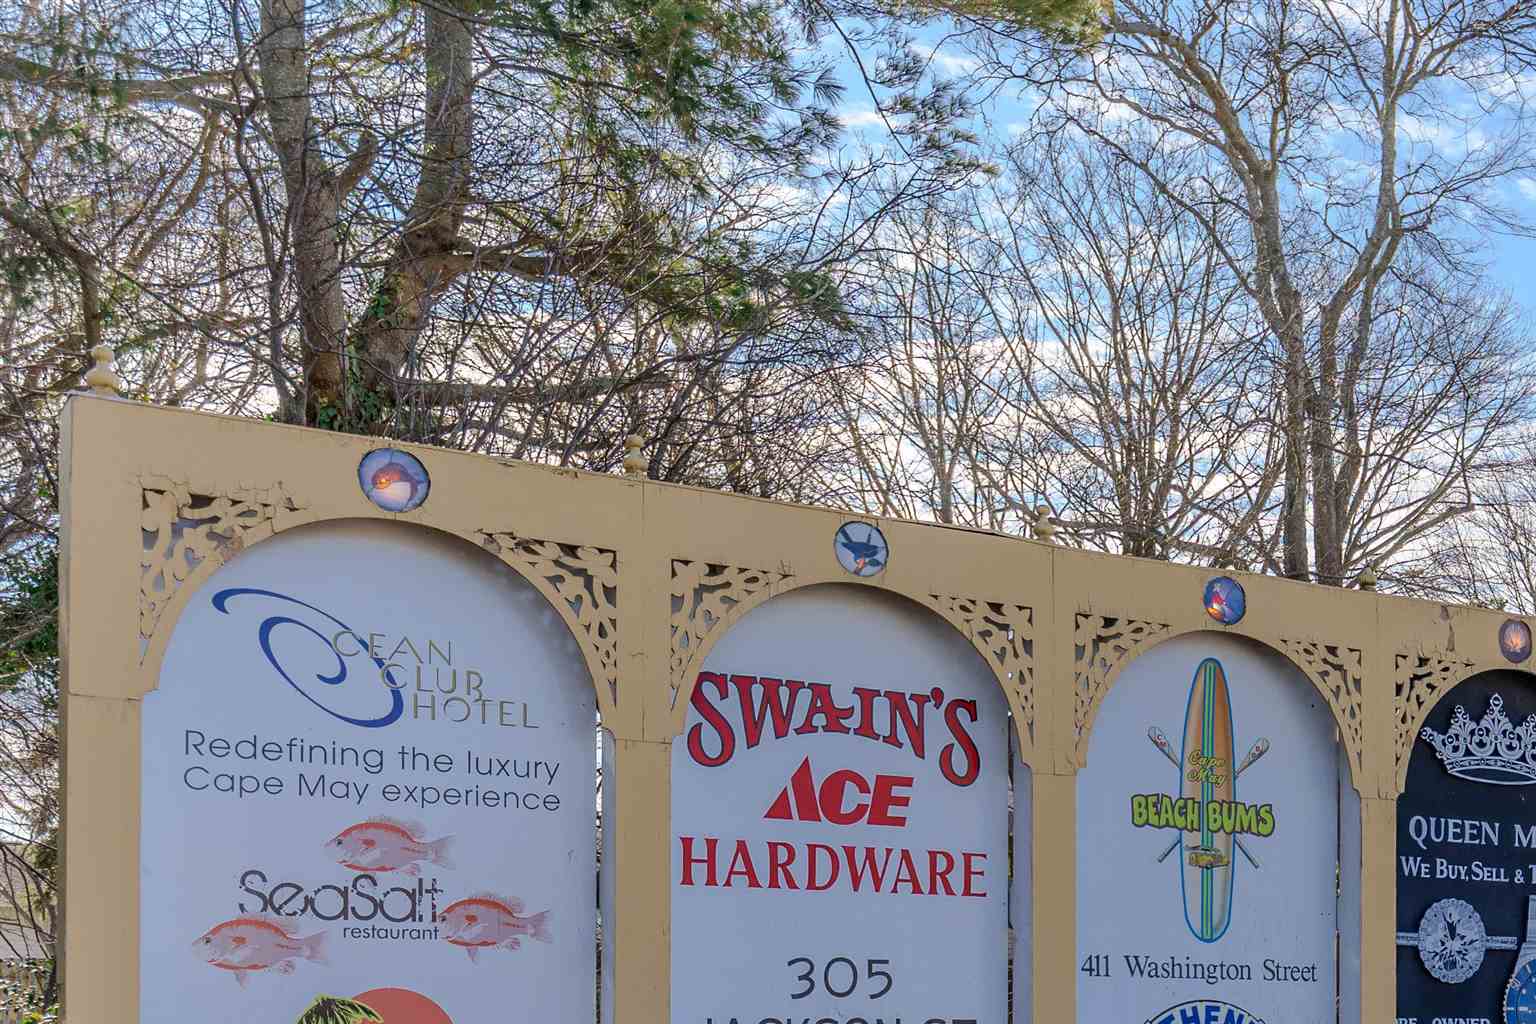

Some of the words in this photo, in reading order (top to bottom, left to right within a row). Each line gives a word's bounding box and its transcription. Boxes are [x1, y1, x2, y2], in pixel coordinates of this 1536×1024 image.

[412, 692, 541, 728] HOTEL
[687, 671, 981, 787] SWAIN'S
[184, 729, 384, 774] Redefining
[399, 745, 453, 773] the
[467, 750, 560, 785] luxury
[183, 766, 283, 798] Cape
[299, 774, 369, 803] May
[382, 782, 561, 811] experience
[763, 755, 914, 827] ACE
[1131, 793, 1201, 832] BEACH
[1207, 800, 1275, 837] BUMS
[1408, 815, 1501, 850] QUEEN
[679, 837, 988, 898] HARDWARE
[1514, 869, 1526, 884] &
[238, 869, 443, 923] SeaSalt
[343, 924, 439, 940] restaurant
[787, 957, 893, 1000] 305
[1081, 954, 1112, 977] 411
[1124, 954, 1252, 984] Washington
[1263, 959, 1318, 982] Street
